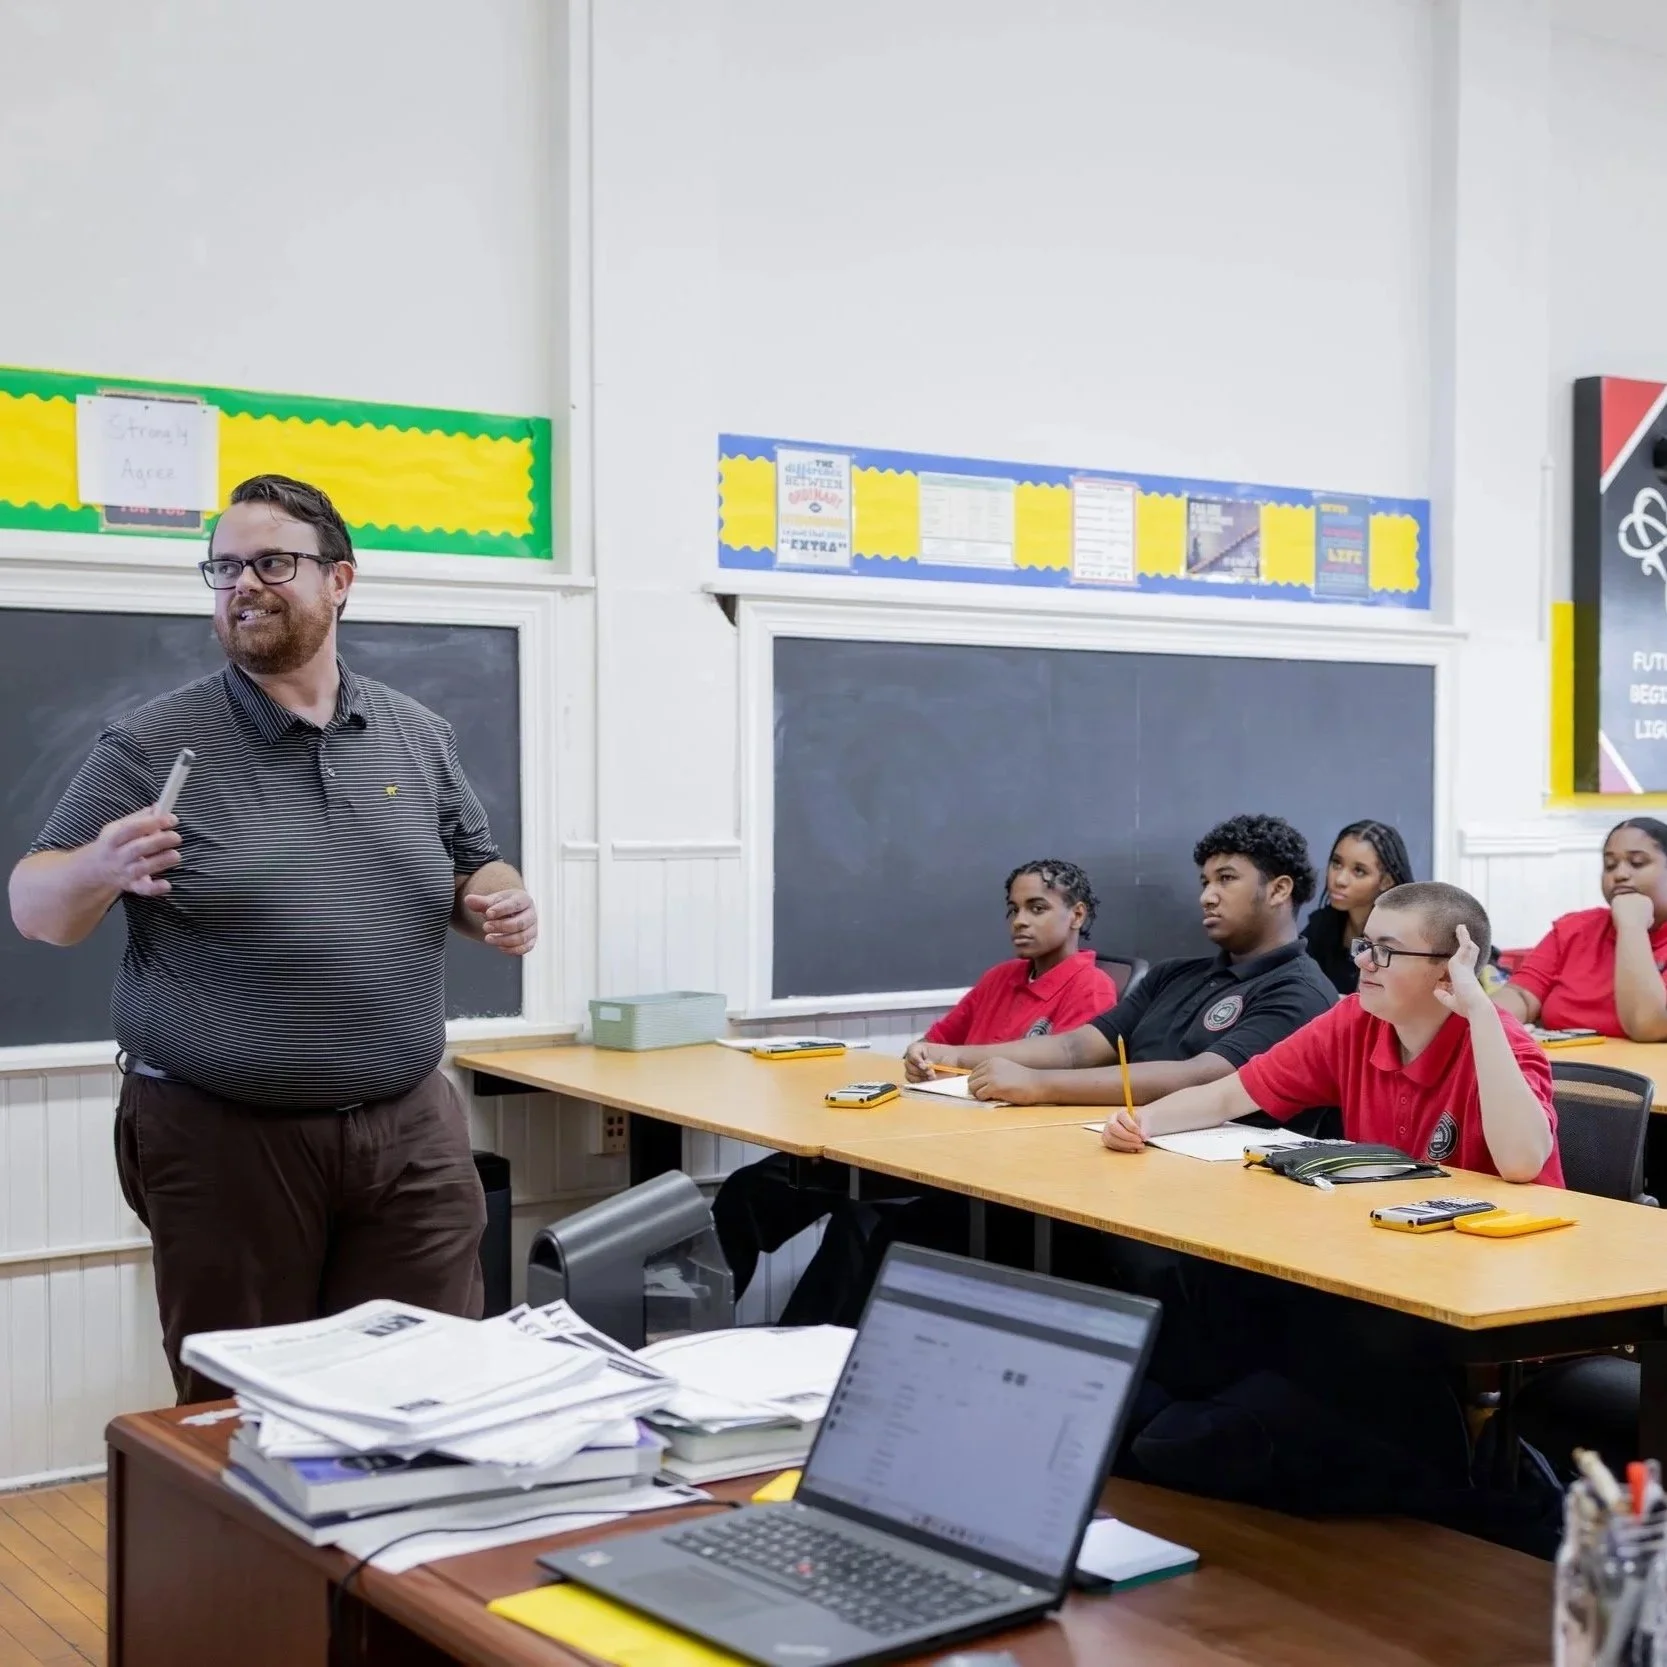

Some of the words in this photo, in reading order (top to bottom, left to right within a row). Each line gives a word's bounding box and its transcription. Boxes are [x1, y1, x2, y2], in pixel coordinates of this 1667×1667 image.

[107, 414, 188, 446] Strongly
[121, 457, 177, 489] Agree
[815, 459, 834, 468] THE
[785, 475, 843, 489] BETWEEN
